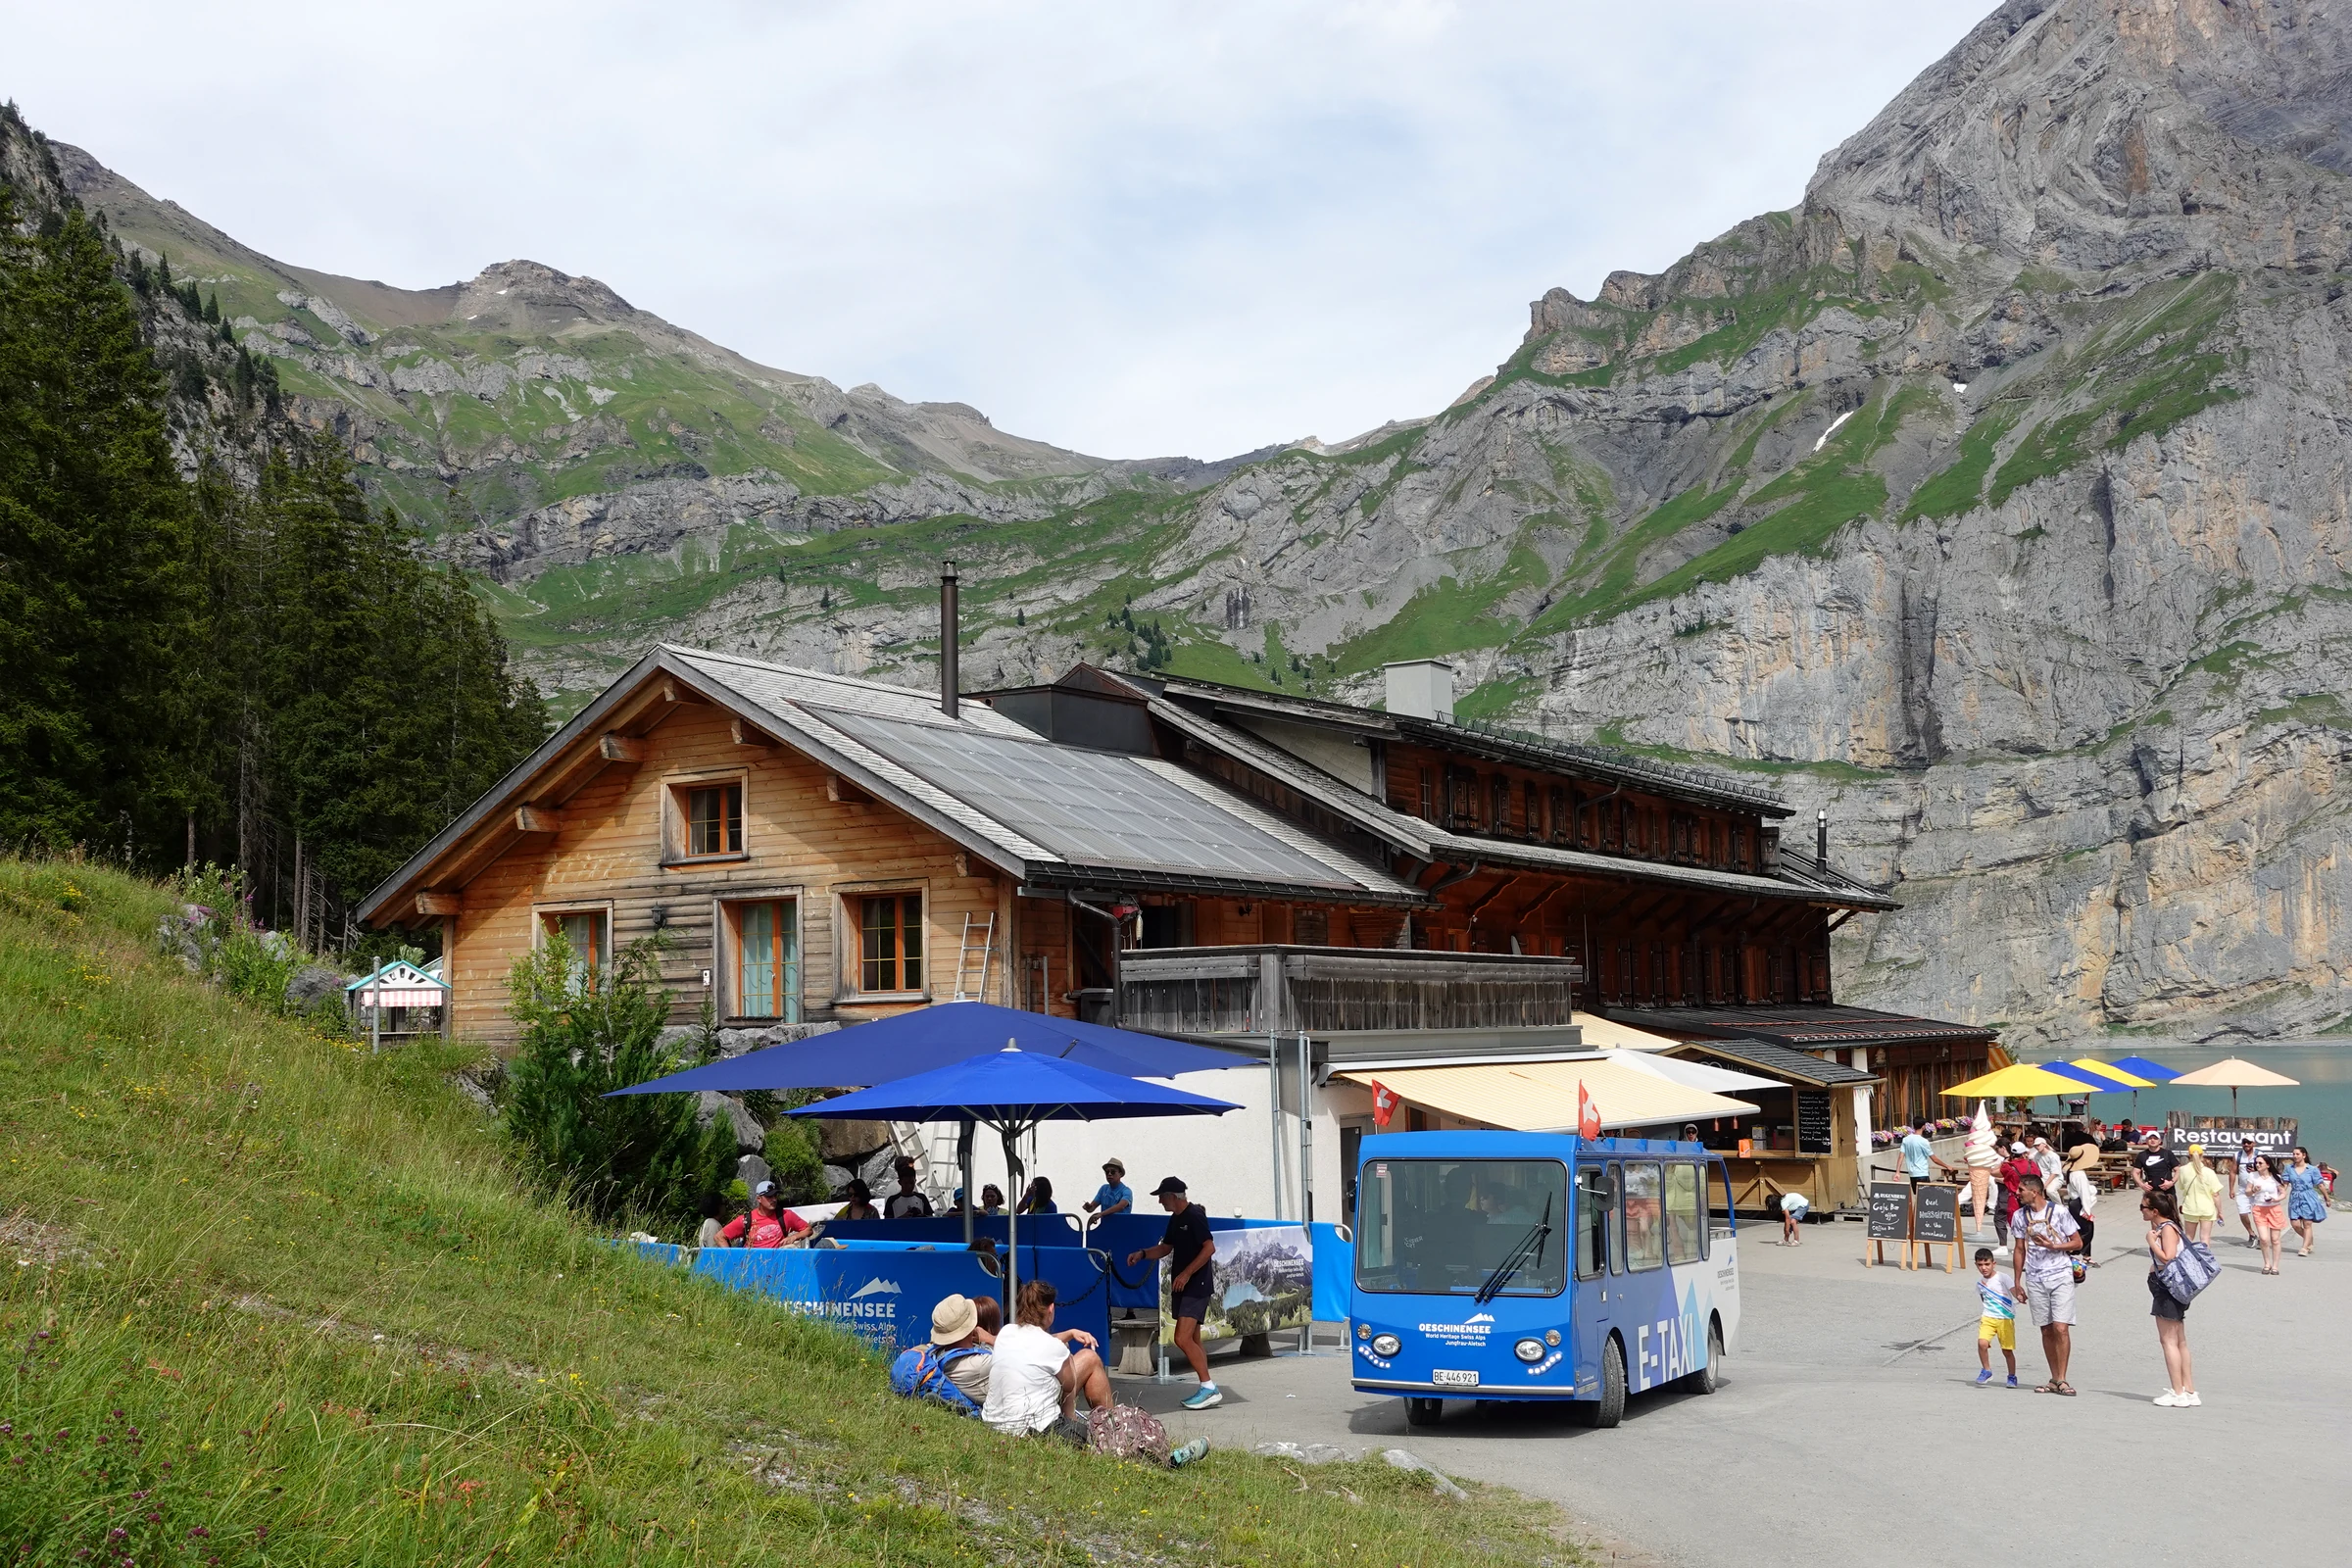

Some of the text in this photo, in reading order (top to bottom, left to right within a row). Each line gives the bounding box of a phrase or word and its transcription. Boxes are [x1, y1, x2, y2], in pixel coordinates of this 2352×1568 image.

[772, 1300, 896, 1318] SCHINENSEE
[1418, 1323, 1492, 1334] OESCHINENSEE
[1638, 1312, 1695, 1392] E-TAXI
